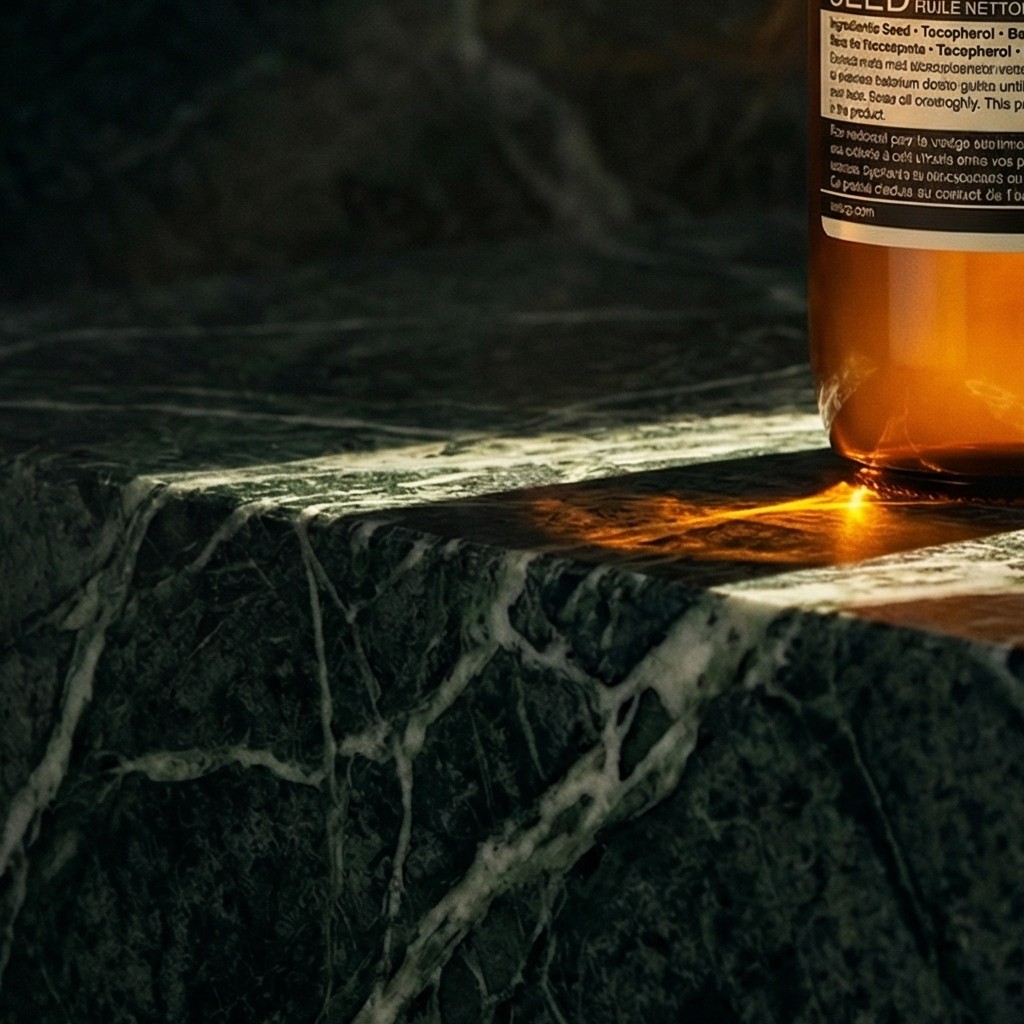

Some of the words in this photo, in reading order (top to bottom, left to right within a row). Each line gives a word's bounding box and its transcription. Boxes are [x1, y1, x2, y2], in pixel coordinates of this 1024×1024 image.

[984, 97, 1011, 110] This
[992, 157, 1014, 167] vos
[1007, 175, 1023, 184] ou
